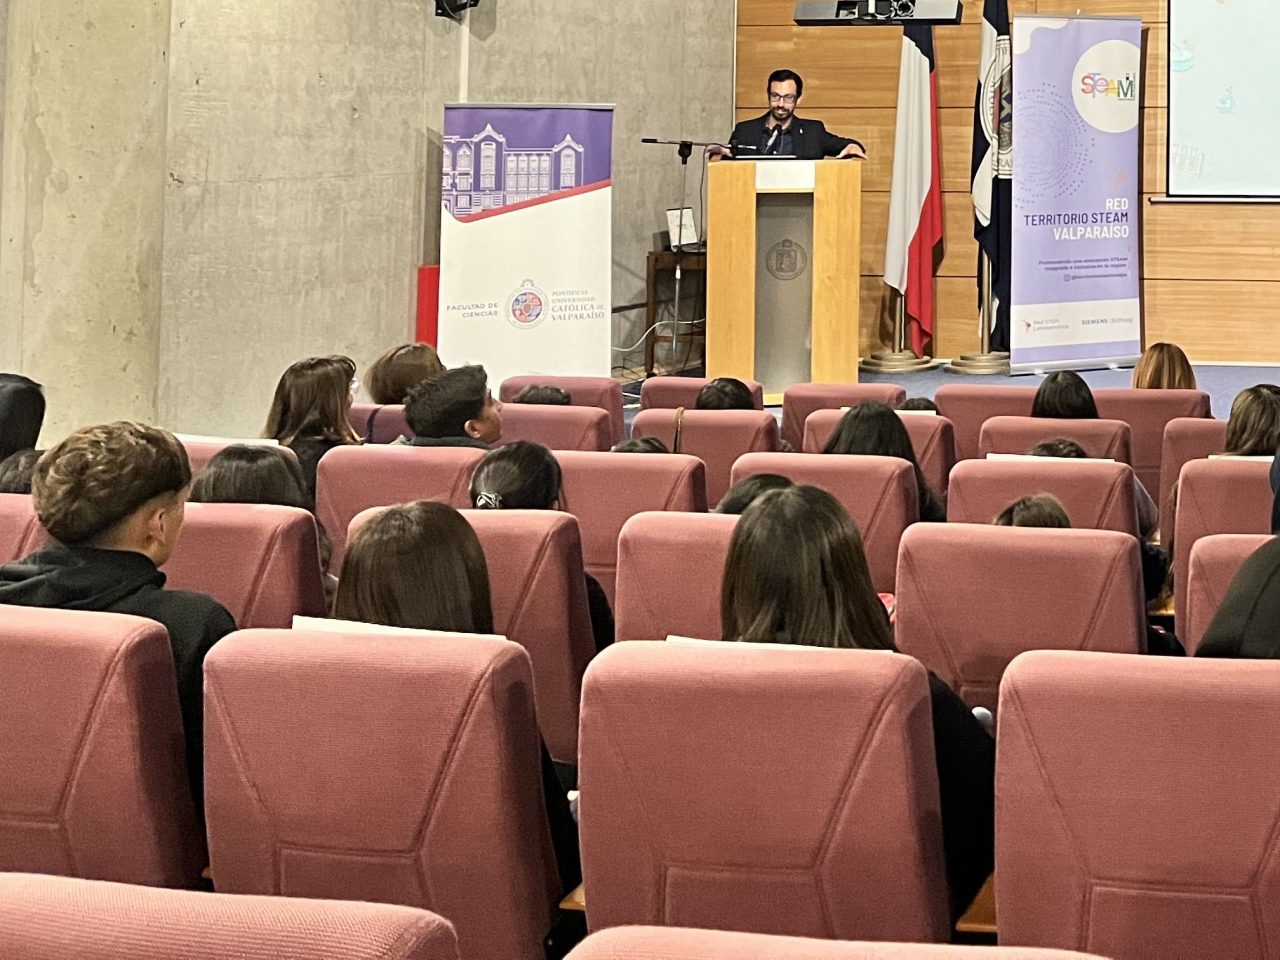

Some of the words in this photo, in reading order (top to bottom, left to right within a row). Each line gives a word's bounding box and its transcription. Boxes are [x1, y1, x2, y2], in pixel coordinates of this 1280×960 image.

[1105, 198, 1129, 210] RED
[1023, 213, 1089, 226] TERRITORIO
[1091, 212, 1129, 223] STEAM
[1053, 224, 1130, 240] VALPARAÍSO
[446, 302, 486, 311] FACULTAD
[551, 302, 595, 313] CATÓLICA
[462, 310, 499, 319] CIENCIAS
[551, 311, 605, 321] VALPARAÍSO
